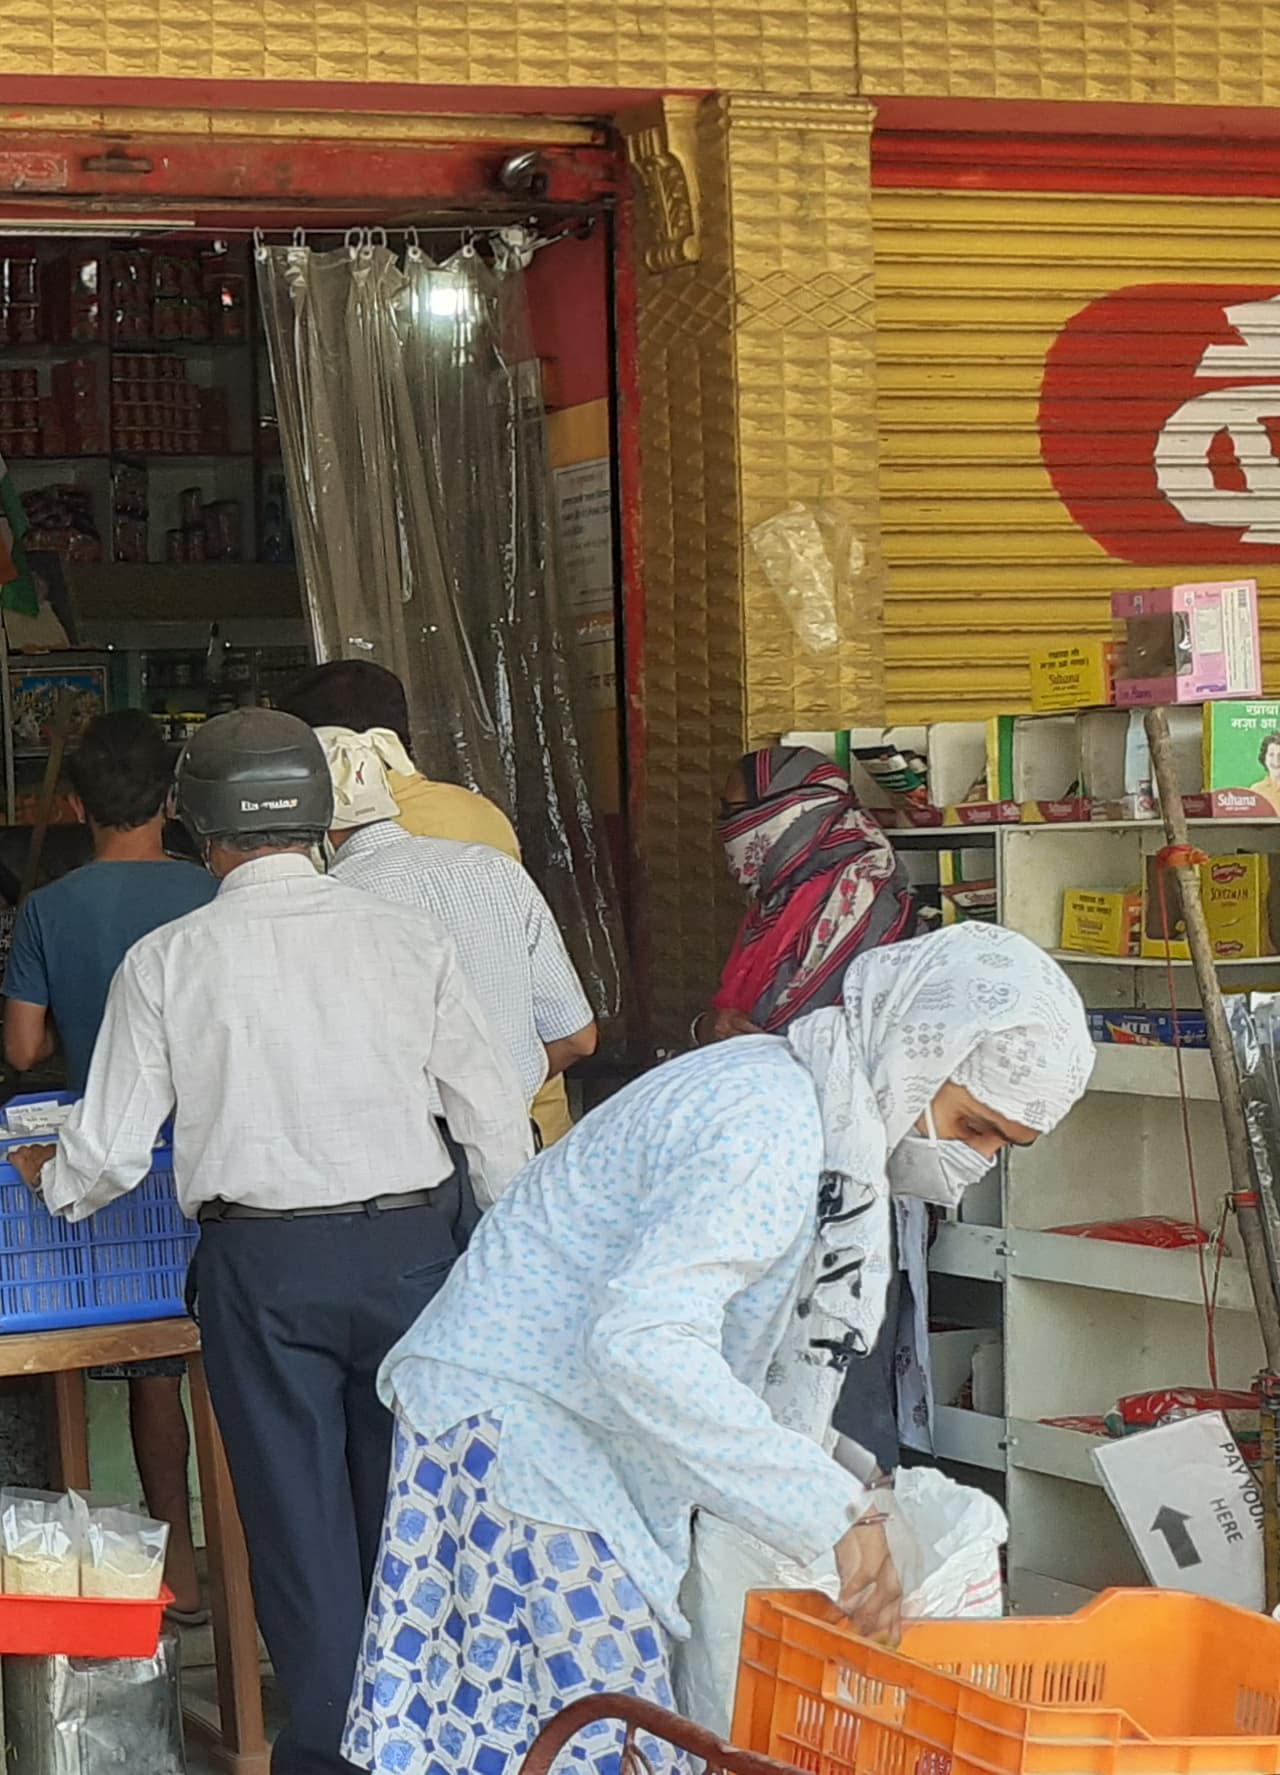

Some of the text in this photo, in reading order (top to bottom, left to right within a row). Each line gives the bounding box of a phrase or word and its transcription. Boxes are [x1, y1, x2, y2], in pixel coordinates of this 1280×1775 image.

[1218, 791, 1256, 807] Suhana
[1219, 1442, 1249, 1475] PAY
[1210, 1497, 1244, 1545] HERE
